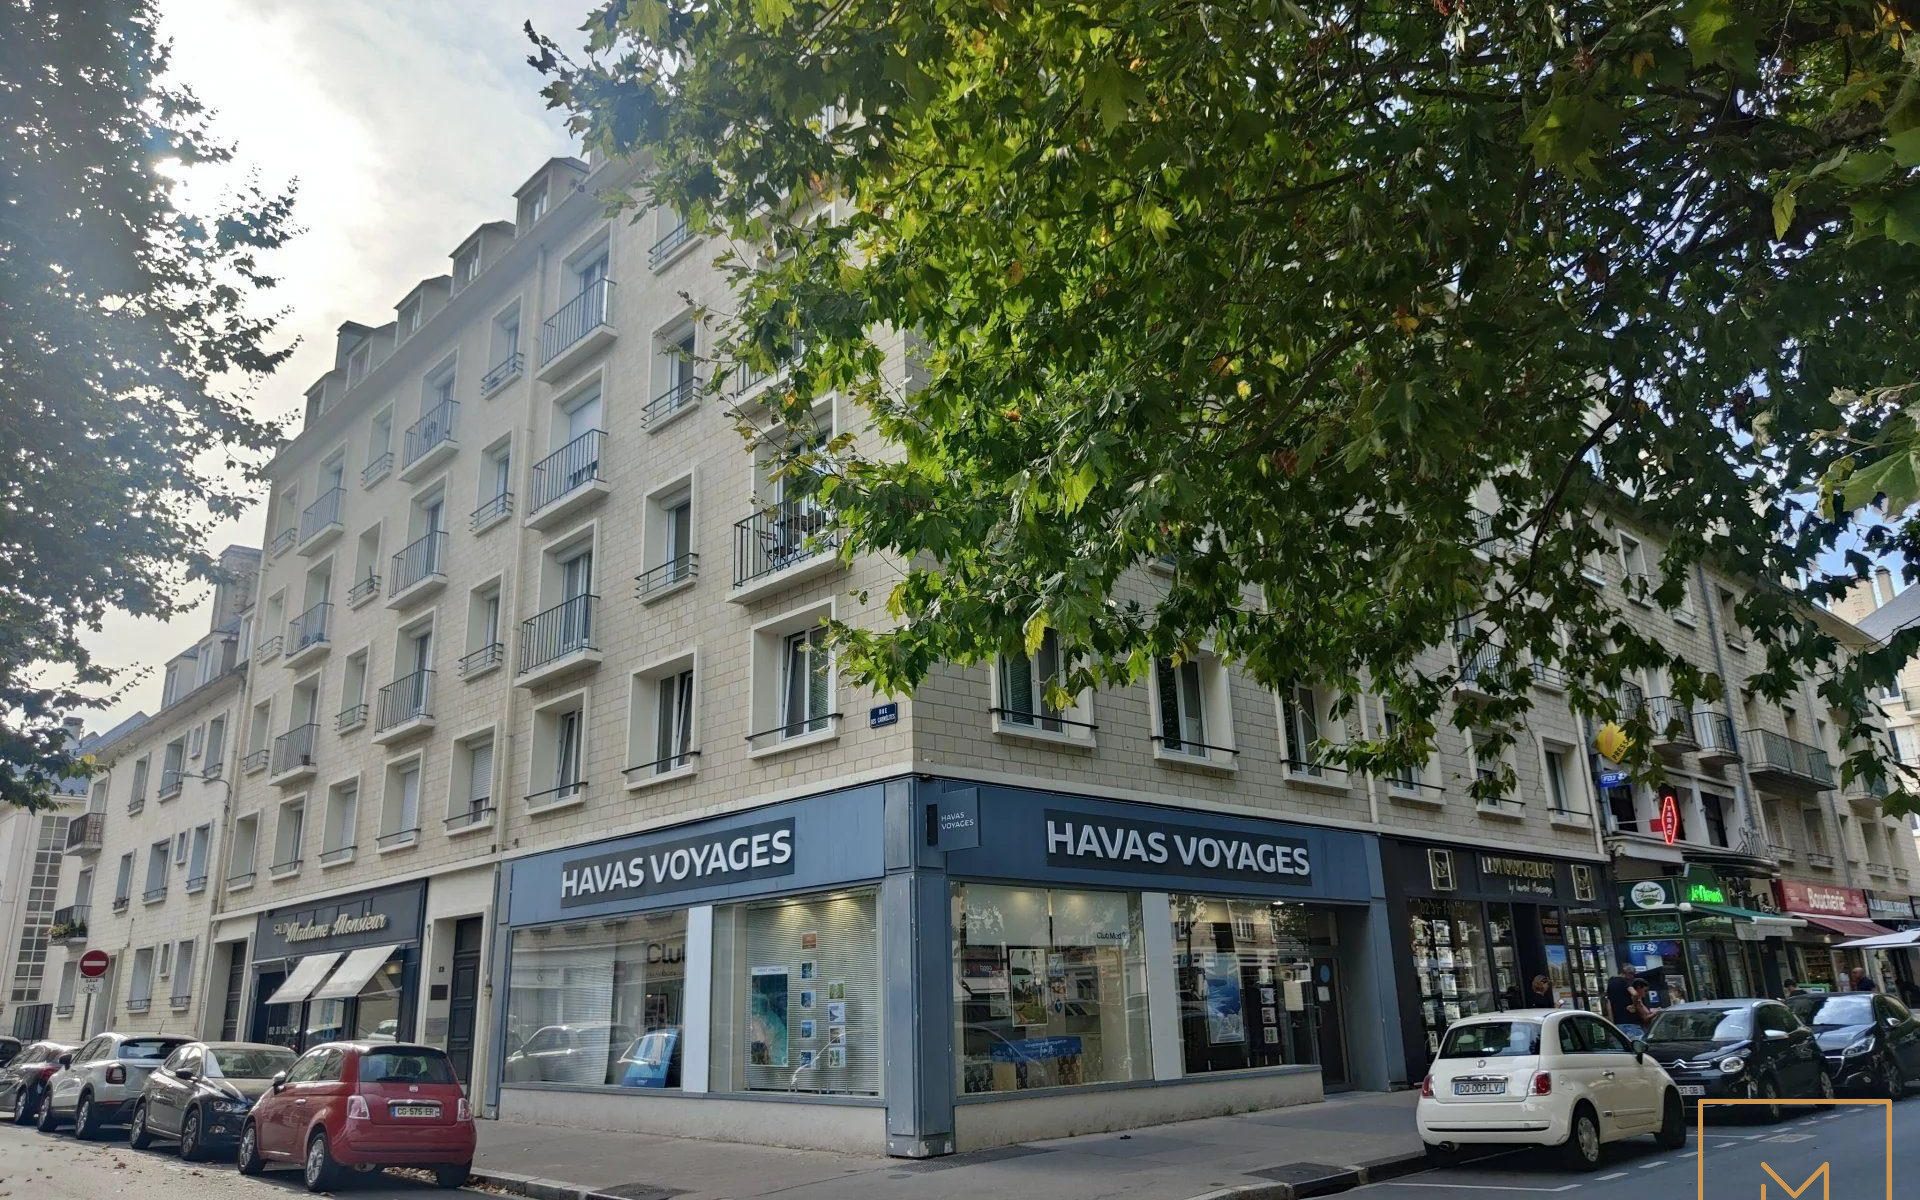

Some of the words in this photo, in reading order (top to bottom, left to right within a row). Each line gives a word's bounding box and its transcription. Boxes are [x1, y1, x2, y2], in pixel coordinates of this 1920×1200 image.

[941, 811, 965, 822] HAVAS
[941, 818, 974, 830] VOYAGES
[1047, 820, 1168, 864] HAVAS
[1173, 834, 1310, 876] VOYAGES
[561, 857, 643, 898] HAVAS
[650, 829, 792, 884] VOYAGES
[1807, 887, 1847, 911] Boucherie
[285, 919, 330, 943] Madame
[332, 912, 387, 936] Monsieur
